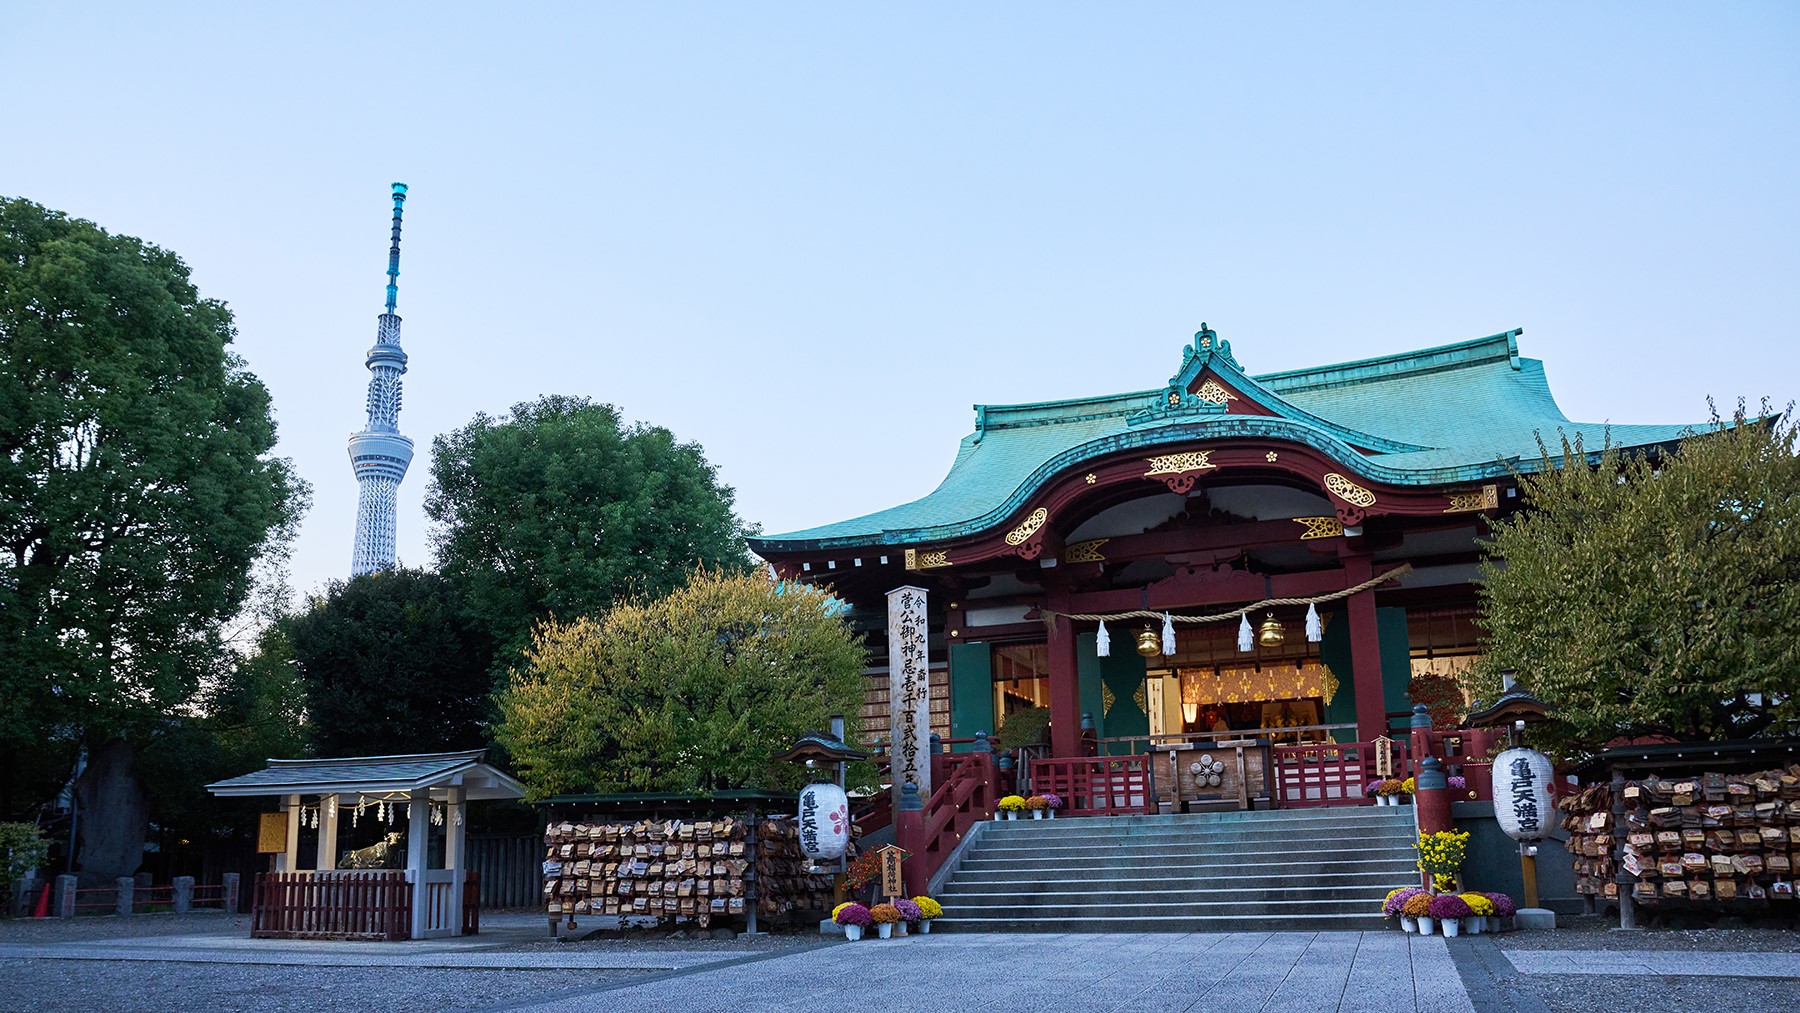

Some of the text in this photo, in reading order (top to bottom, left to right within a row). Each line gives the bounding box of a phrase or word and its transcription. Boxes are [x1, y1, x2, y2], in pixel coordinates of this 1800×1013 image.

[801, 791, 819, 853] 亀戸天満宮
[1509, 757, 1539, 833] 亀戸天満宮
